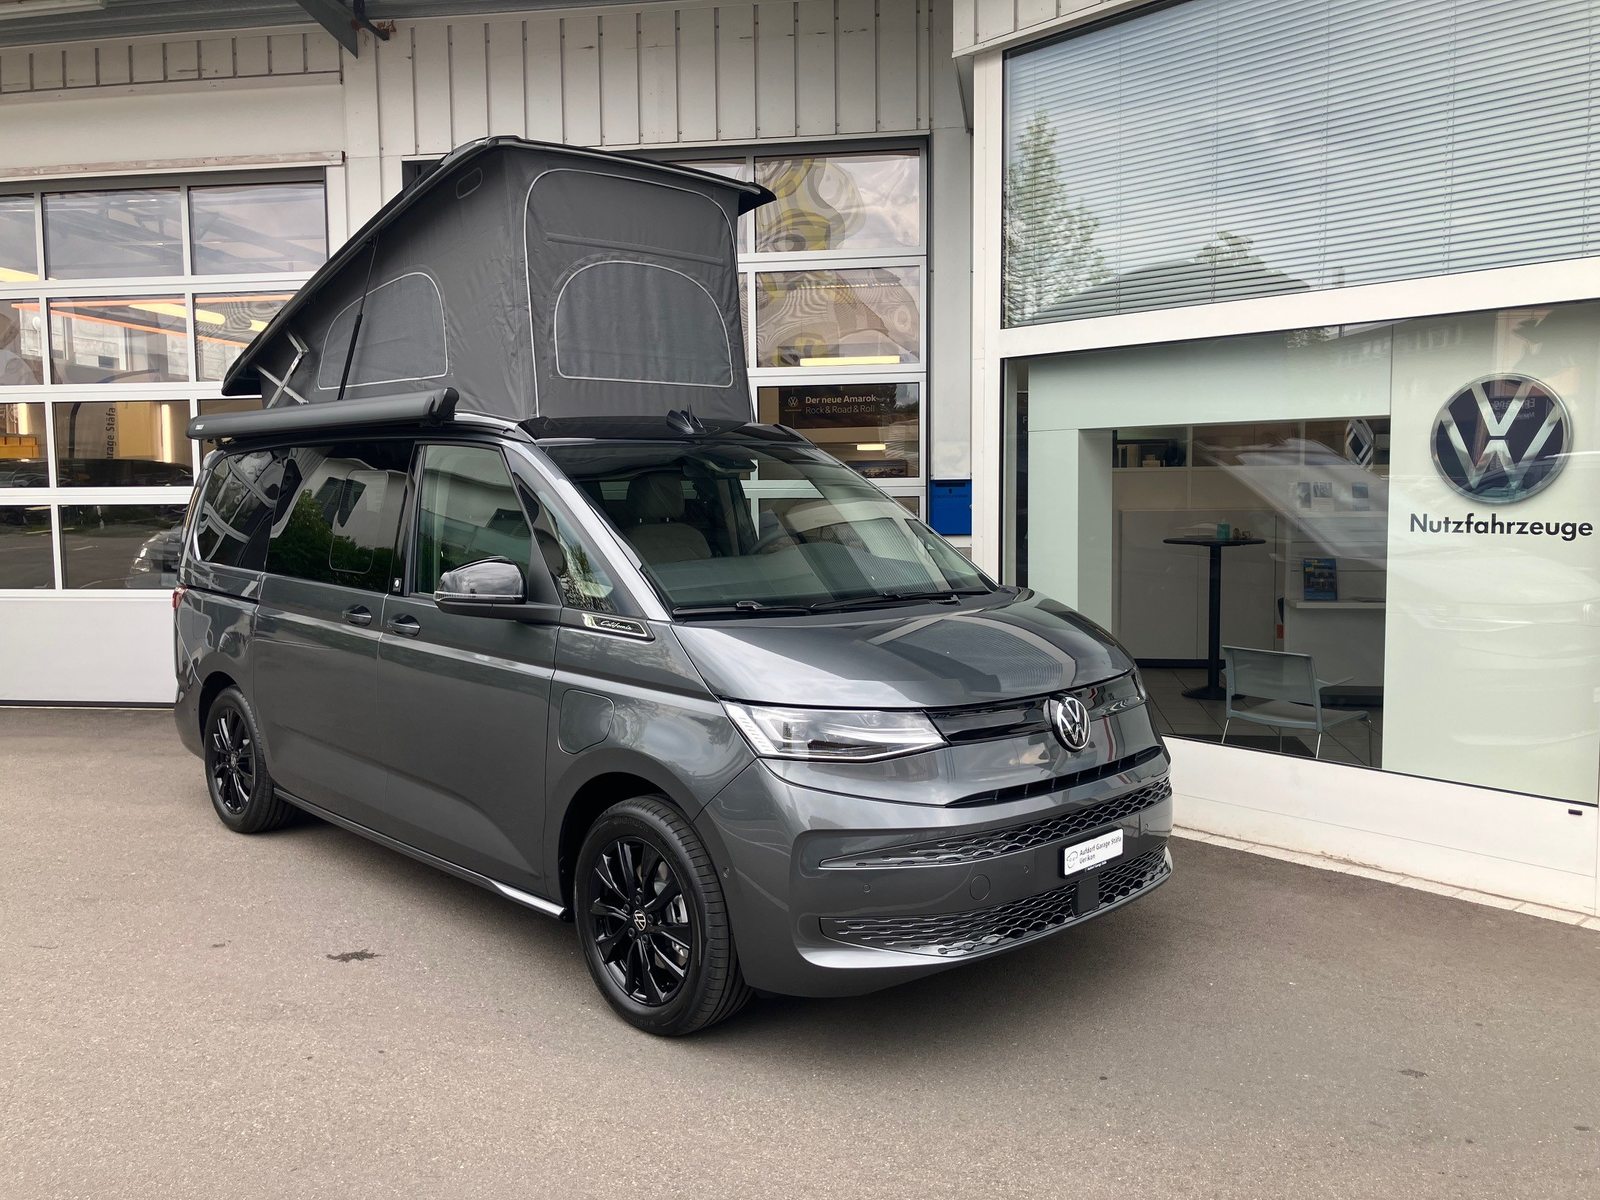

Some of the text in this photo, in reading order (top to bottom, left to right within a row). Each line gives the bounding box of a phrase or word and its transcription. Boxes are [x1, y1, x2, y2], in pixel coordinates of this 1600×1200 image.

[805, 396, 820, 404] Der
[843, 394, 877, 403] Amarok
[805, 404, 875, 414] Rock & Road & Roll
[105, 407, 116, 432] Stäfa
[1409, 512, 1594, 542] Nutzfahrzeuge
[600, 620, 632, 630] California
[1079, 845, 1096, 856] Aufdorf
[1095, 840, 1111, 850] Garage
